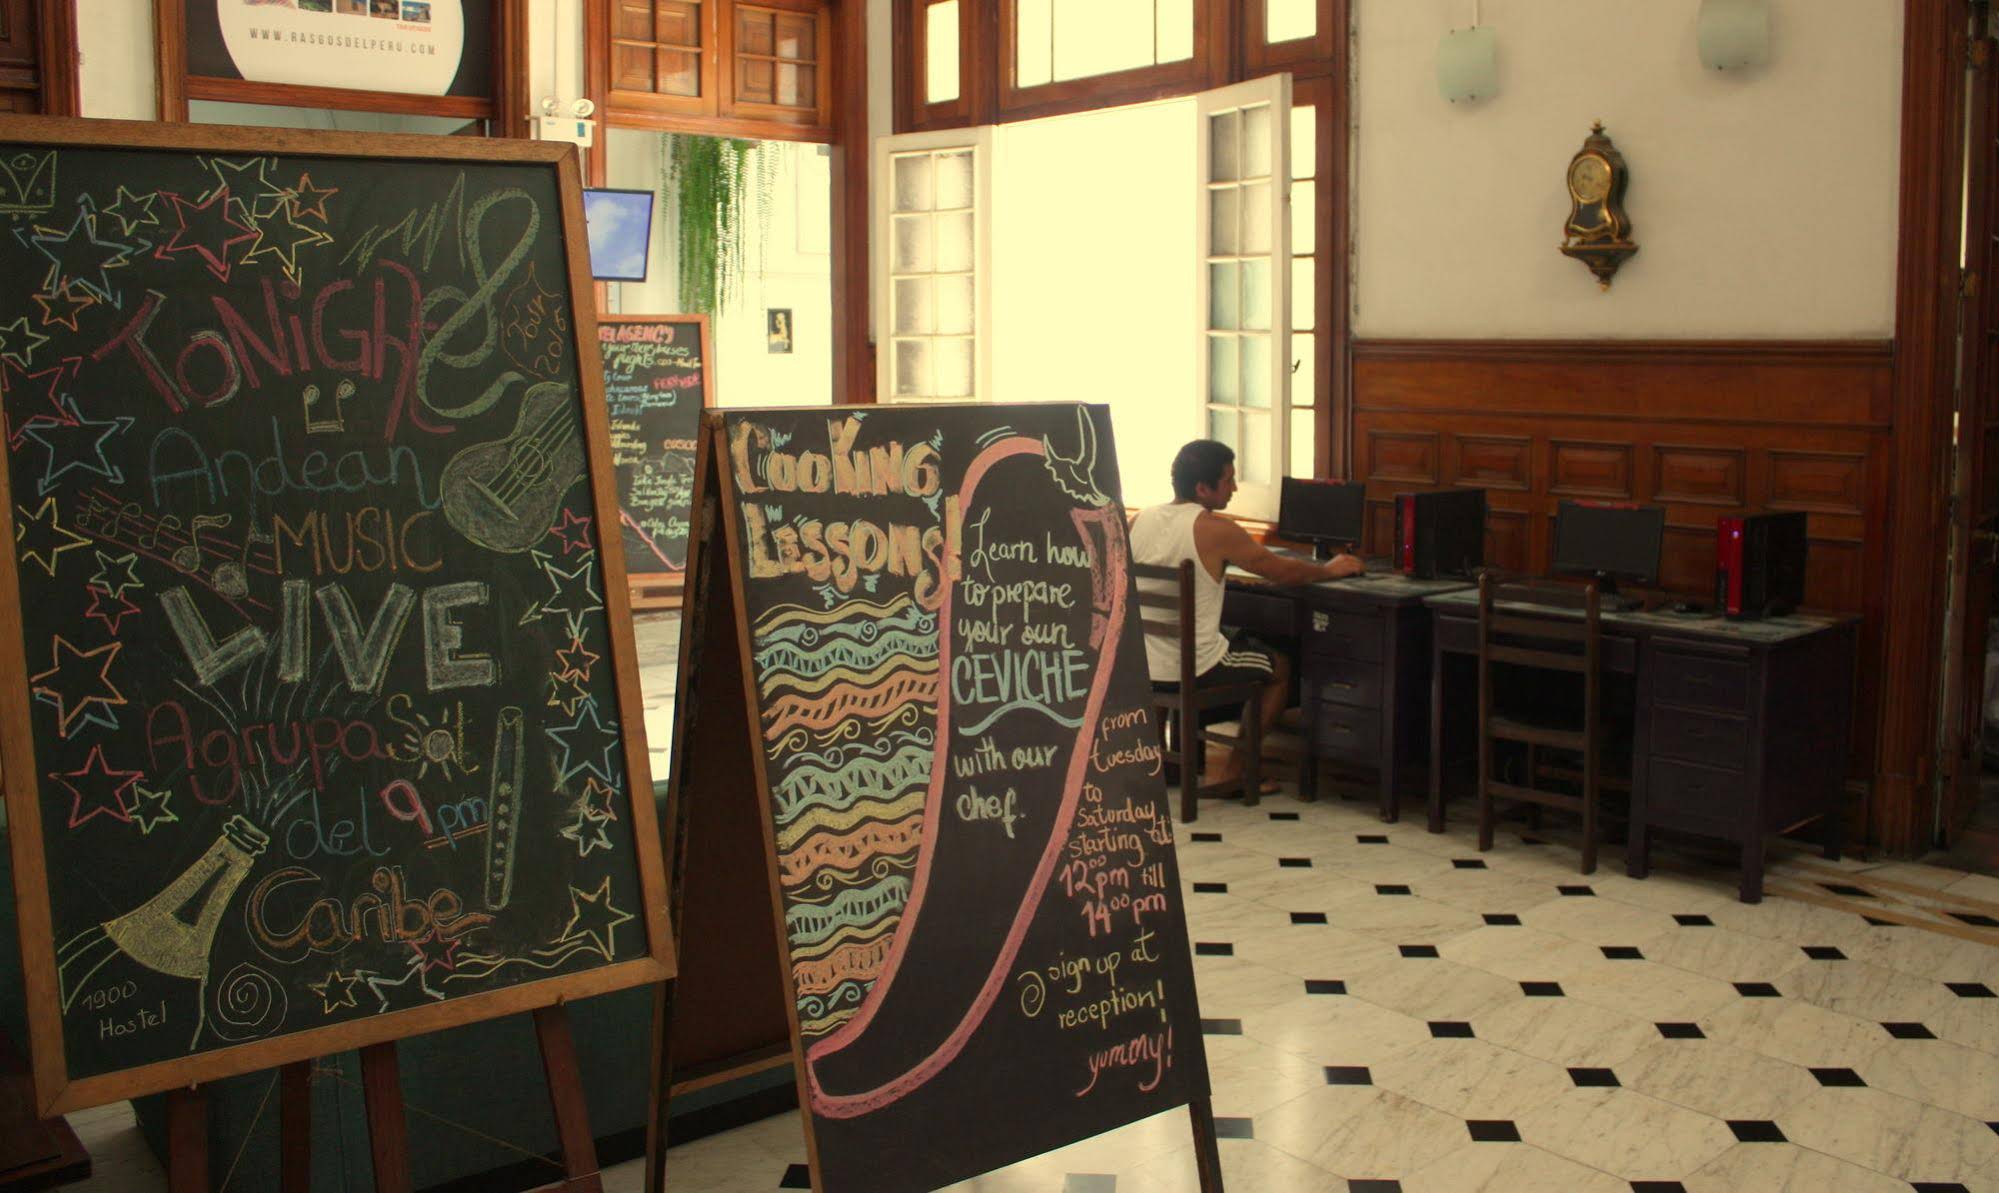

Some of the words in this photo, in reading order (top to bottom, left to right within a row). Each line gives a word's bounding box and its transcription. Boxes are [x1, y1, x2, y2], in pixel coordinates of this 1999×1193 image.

[150, 415, 442, 511] Andean
[273, 507, 444, 575] MUSIC
[969, 506, 1039, 584] Learn
[1046, 530, 1093, 569] how
[960, 574, 991, 607] to
[991, 579, 1076, 625] prepare
[158, 578, 498, 697] LIVE
[958, 617, 1014, 653] your
[951, 648, 1090, 706] CEVICHE
[1101, 707, 1148, 742] from
[953, 735, 1008, 778] with
[1011, 744, 1059, 771] our
[1082, 781, 1103, 803] to
[286, 786, 392, 858] del
[1068, 827, 1145, 868] starting
[1141, 861, 1166, 889] till
[244, 865, 497, 965] Caribe
[1096, 951, 1121, 987] up
[1131, 926, 1161, 963] at
[82, 979, 138, 1009] 1900
[99, 999, 167, 1041] Hostel
[1058, 978, 1168, 1030] reception!
[1075, 1024, 1173, 1098] yummy!
